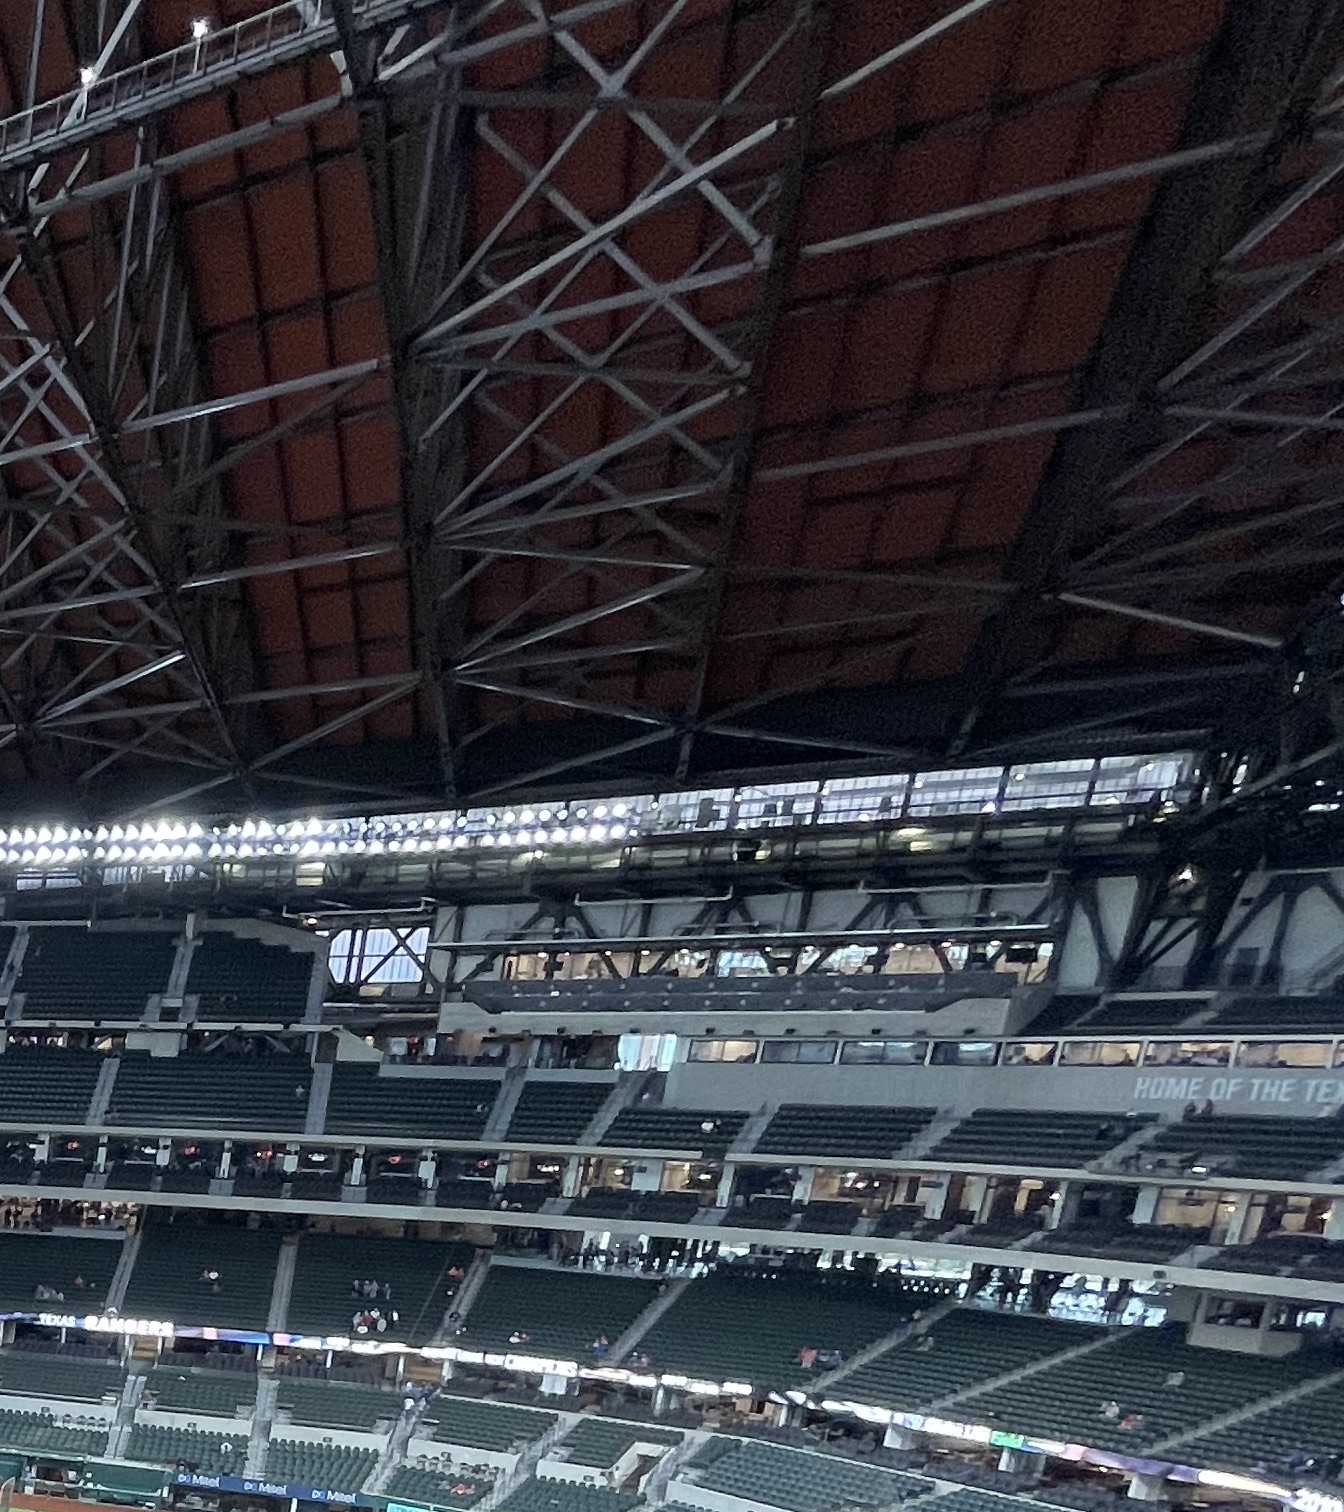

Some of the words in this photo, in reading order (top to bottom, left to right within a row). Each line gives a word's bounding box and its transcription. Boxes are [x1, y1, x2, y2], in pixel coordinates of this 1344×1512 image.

[1134, 1076, 1205, 1099] HOME
[1210, 1077, 1246, 1100] OF
[1249, 1078, 1295, 1102] THE
[38, 1312, 76, 1328] TEXAS
[84, 1315, 175, 1337] RANGERS
[192, 1475, 220, 1488] Mitel
[259, 1482, 287, 1496] Mitel
[327, 1490, 356, 1504] Mitel
